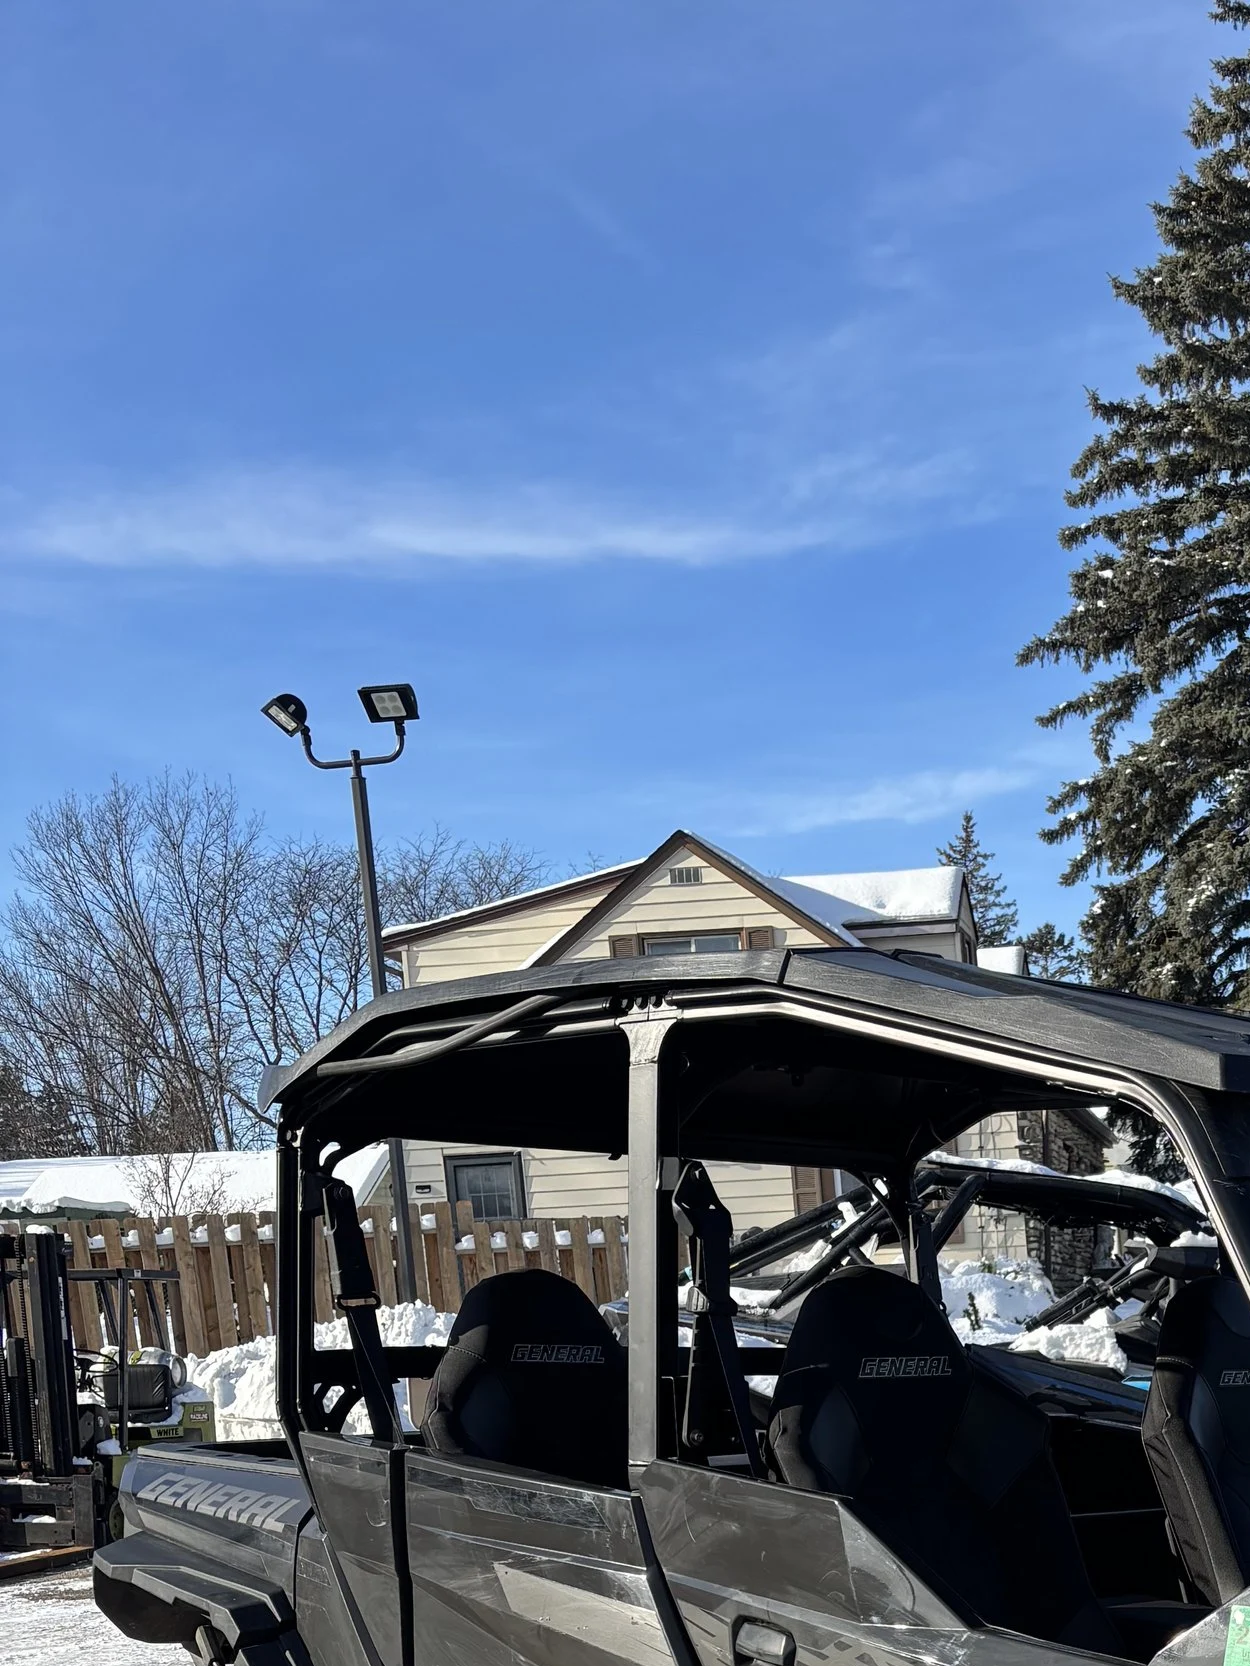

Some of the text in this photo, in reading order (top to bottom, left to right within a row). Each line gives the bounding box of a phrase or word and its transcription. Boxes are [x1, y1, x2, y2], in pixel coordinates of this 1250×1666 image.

[511, 1344, 605, 1364] GENERAL
[859, 1356, 953, 1378] GENERAL
[157, 1428, 180, 1437] WHITE
[136, 1472, 300, 1533] GENERAL
